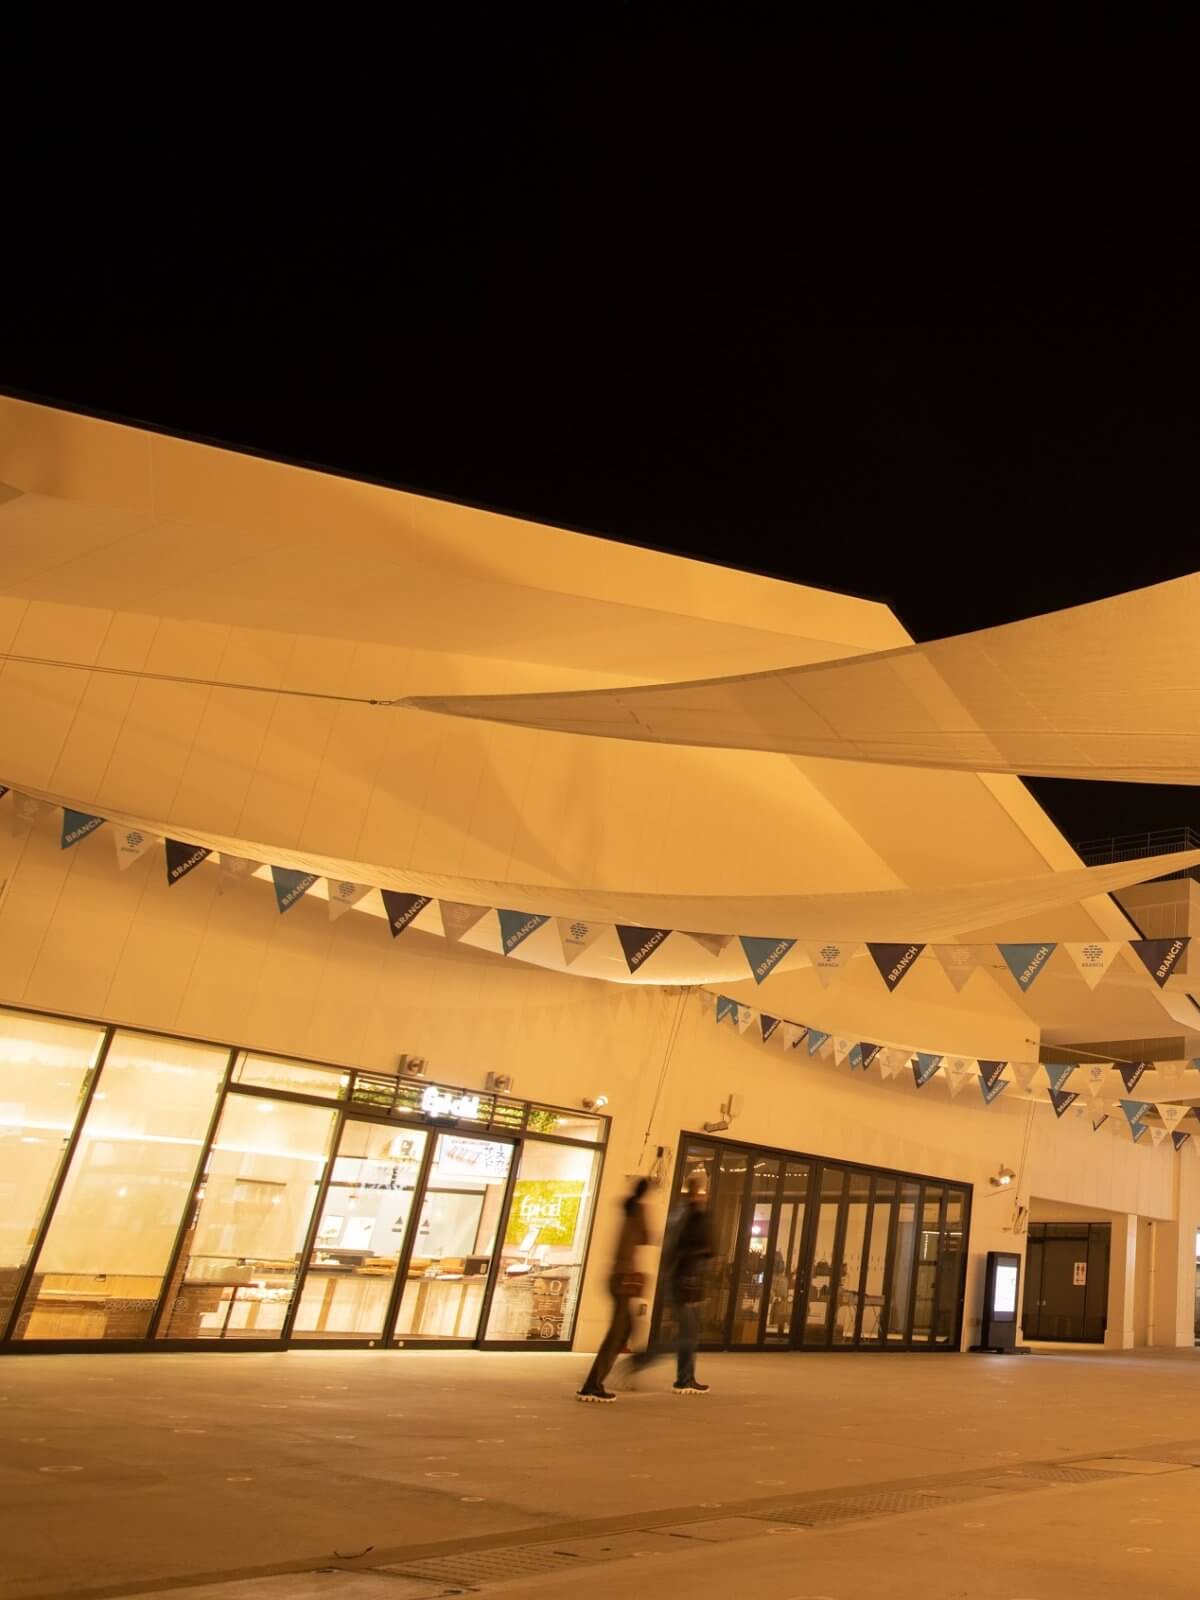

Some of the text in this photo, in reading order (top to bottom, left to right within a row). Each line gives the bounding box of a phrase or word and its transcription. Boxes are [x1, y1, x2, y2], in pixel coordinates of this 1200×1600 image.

[172, 849, 207, 878] BRANCH
[281, 875, 315, 907] BRANCH
[395, 897, 428, 929] BRANCH
[507, 916, 542, 948] BRANCH
[631, 931, 664, 965] BRANCH
[756, 940, 789, 976] BRANCH
[887, 946, 918, 982] BRANCH
[1020, 946, 1049, 983] BRANCH
[1156, 940, 1183, 978] BRANCH
[1128, 1062, 1145, 1087] BRANCH
